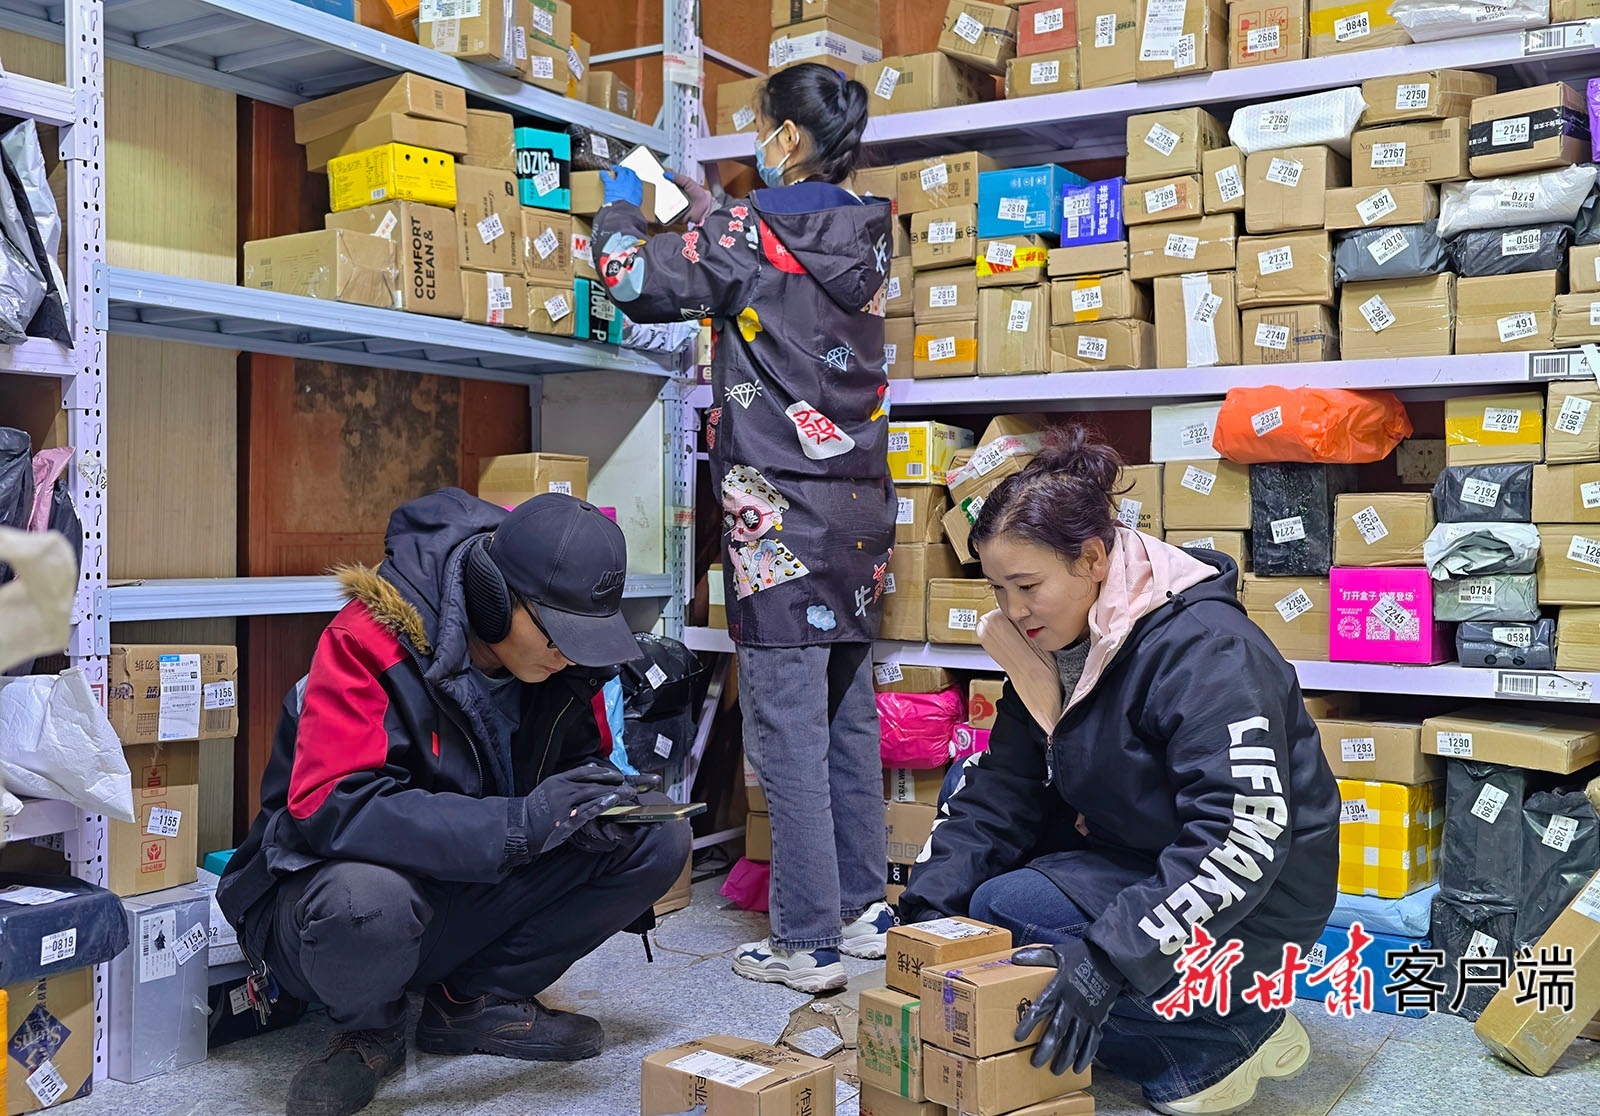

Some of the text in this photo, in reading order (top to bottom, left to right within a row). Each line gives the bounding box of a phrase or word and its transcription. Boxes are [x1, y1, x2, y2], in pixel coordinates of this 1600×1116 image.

[1043, 13, 1061, 25] 2702
[1345, 17, 1368, 32] 0848
[1100, 16, 1109, 38] 2695
[1575, 27, 1583, 38] 4
[1257, 31, 1278, 43] 2668
[1179, 37, 1187, 58] 2651
[1039, 65, 1057, 76] 2701
[1405, 90, 1426, 101] 2750
[1269, 115, 1289, 124] 2768
[1503, 123, 1526, 135] 2745
[1156, 132, 1174, 148] 2758
[1383, 148, 1404, 159] 2767
[1277, 166, 1299, 178] 2760
[1225, 176, 1239, 197] 2795
[1155, 190, 1174, 203] 2789
[1372, 194, 1390, 210] 897
[1511, 191, 1535, 202] 0279
[1007, 204, 1024, 214] 2818
[1072, 198, 1090, 208] 2772
[936, 227, 953, 236] 2814
[1381, 232, 1403, 250] 2070
[1516, 234, 1540, 245] 0504
[1167, 242, 1186, 252] 2781
[411, 216, 424, 299] COMFORT
[1268, 252, 1289, 264] 2737
[425, 245, 435, 300] CLEAN
[937, 290, 955, 299] 2813
[1081, 292, 1099, 302] 2784
[1199, 302, 1214, 323] 2754
[1371, 306, 1390, 327] 2661
[1015, 311, 1025, 329] 2810
[1515, 317, 1533, 329] 491
[1264, 330, 1286, 341] 2740
[936, 342, 953, 352] 2811
[1086, 343, 1104, 352] 2782
[1260, 411, 1279, 425] 2332
[1495, 414, 1518, 424] 2207
[1565, 411, 1581, 431] 1985
[1189, 427, 1208, 438] 2322
[892, 436, 908, 446] 2379
[982, 449, 1000, 465] 2364
[1192, 473, 1212, 486] 2337
[1473, 485, 1497, 499] 2192
[1358, 513, 1376, 533] 2236
[1275, 526, 1295, 538] 2274
[1470, 585, 1492, 595] 0794
[1286, 594, 1307, 611] 2268
[958, 613, 976, 623] 2361
[1384, 605, 1406, 624] 2245
[1507, 633, 1529, 642] 0584
[1548, 679, 1556, 689] 4
[214, 688, 232, 699] 1156
[1352, 743, 1372, 753] 1293
[1448, 738, 1469, 748] 1290
[1345, 805, 1365, 815] 1304
[1481, 798, 1498, 818] 1289
[158, 816, 178, 828] 1155
[1552, 826, 1568, 848] 1285
[52, 935, 74, 952] 0819
[182, 929, 203, 950] 1154
[42, 1074, 60, 1097] 0791
